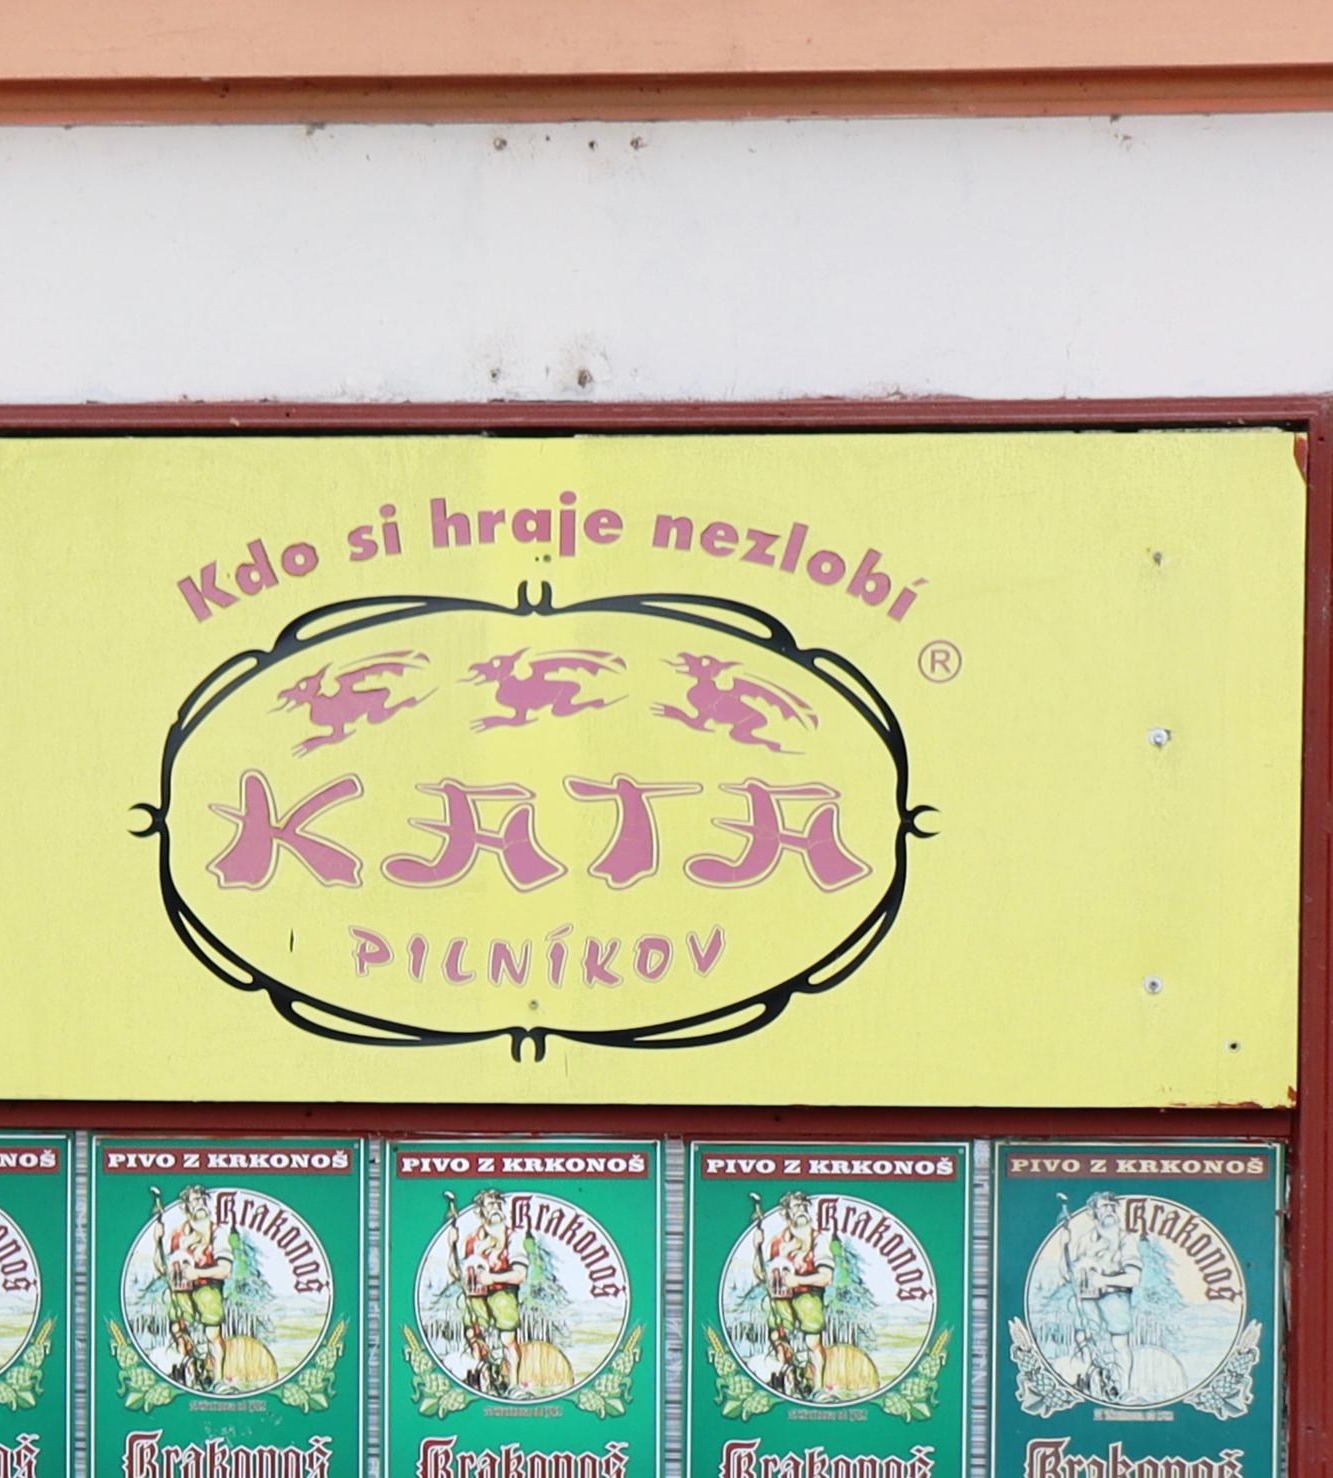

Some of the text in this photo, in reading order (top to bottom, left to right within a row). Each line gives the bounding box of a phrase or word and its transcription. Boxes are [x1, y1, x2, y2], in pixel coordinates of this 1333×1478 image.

[177, 490, 929, 623] Kdo si hraje nezlobí
[205, 769, 873, 893] KATA
[348, 923, 727, 988] PILNÍKOV
[108, 1150, 349, 1169] PIVO Z KRKONOŠ
[401, 1153, 645, 1173] PIVO Z KRKONOŠ
[706, 1156, 954, 1176] PIVO Z KRKONOŠ
[1010, 1157, 1264, 1174] PIVO Z KRKONOŠ
[216, 1192, 330, 1294] Krakonoš
[512, 1195, 626, 1298] Krakonoš
[817, 1197, 933, 1301] Krakonoš
[1124, 1198, 1243, 1302] Krakonoš
